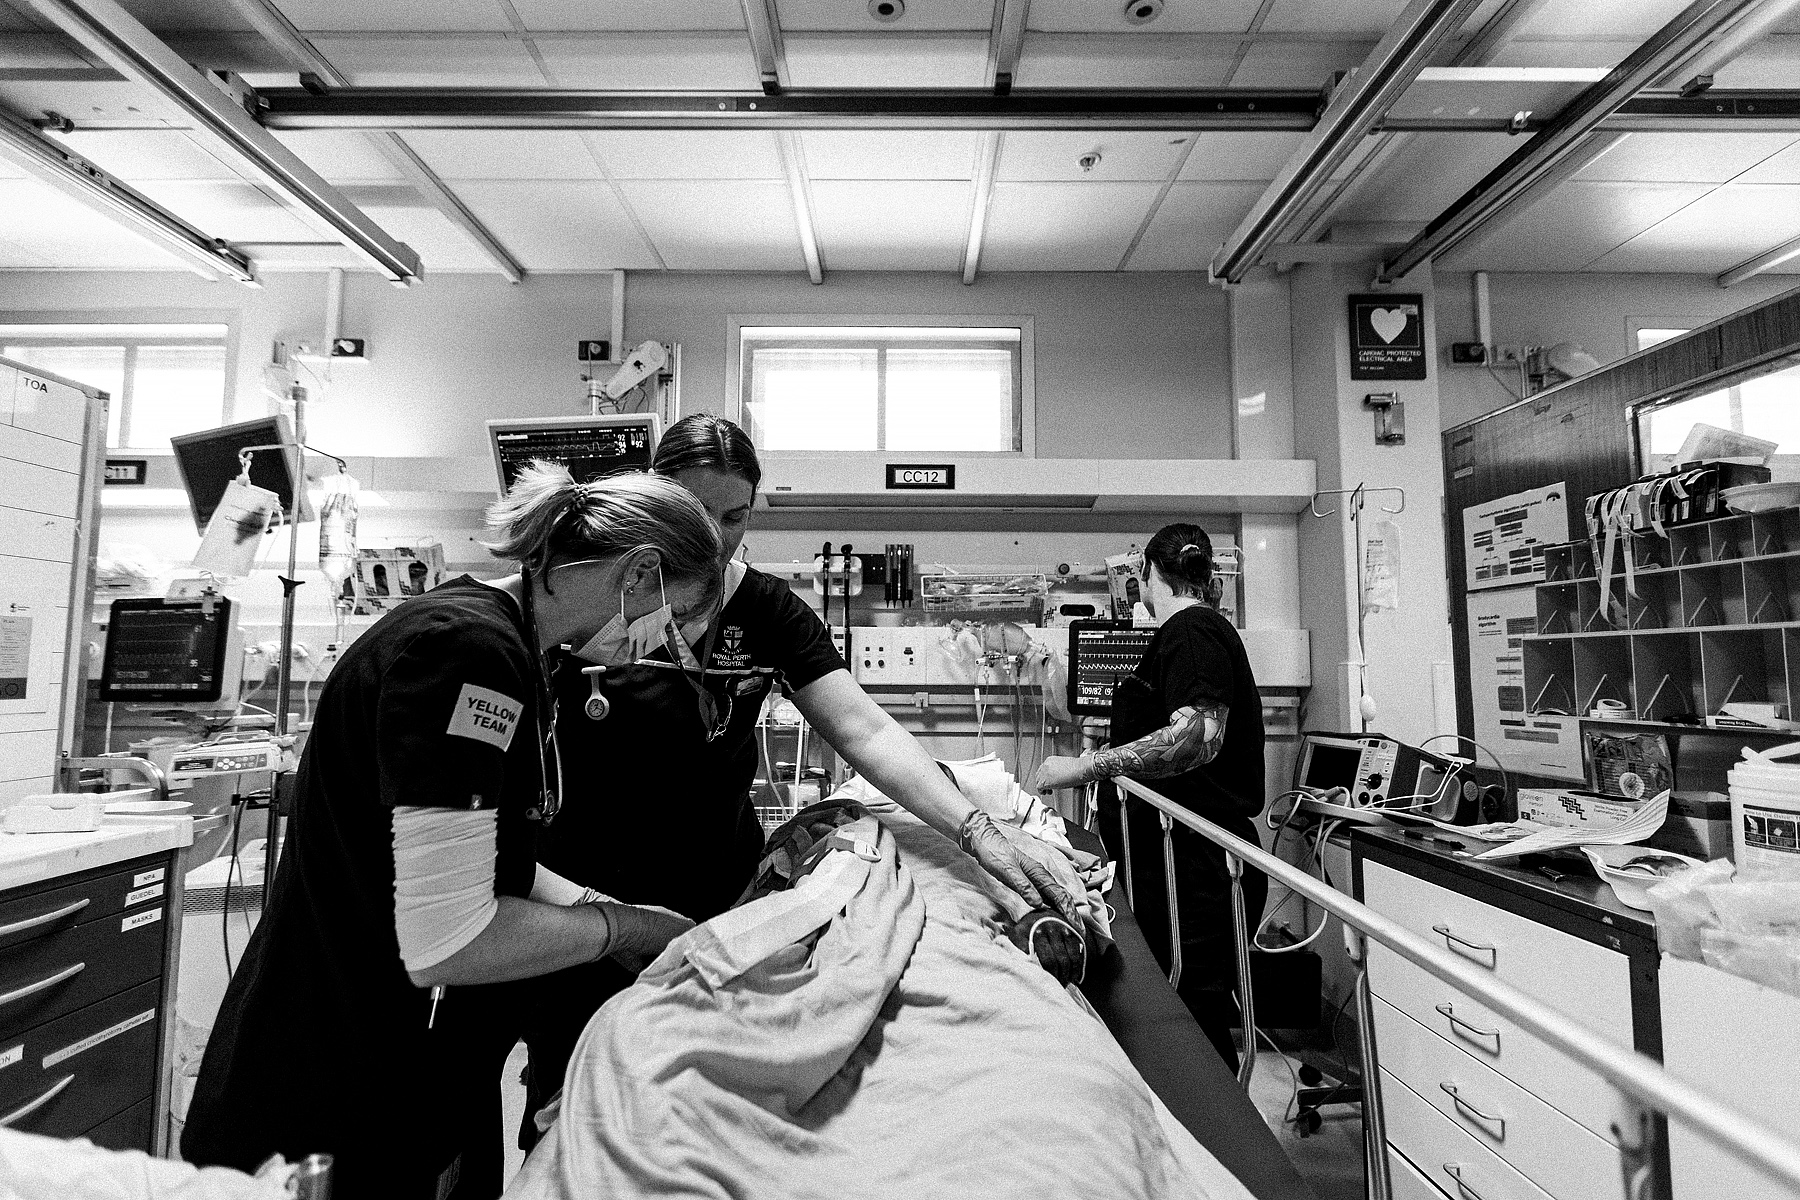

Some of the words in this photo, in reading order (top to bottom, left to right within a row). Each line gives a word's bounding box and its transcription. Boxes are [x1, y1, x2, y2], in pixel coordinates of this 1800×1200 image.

[23, 376, 48, 394] TOA
[903, 470, 939, 483] CC12
[468, 697, 517, 723] YELLOW
[473, 713, 507, 735] TEAM
[131, 889, 155, 901] GUEDEL
[131, 913, 153, 924] MASKS
